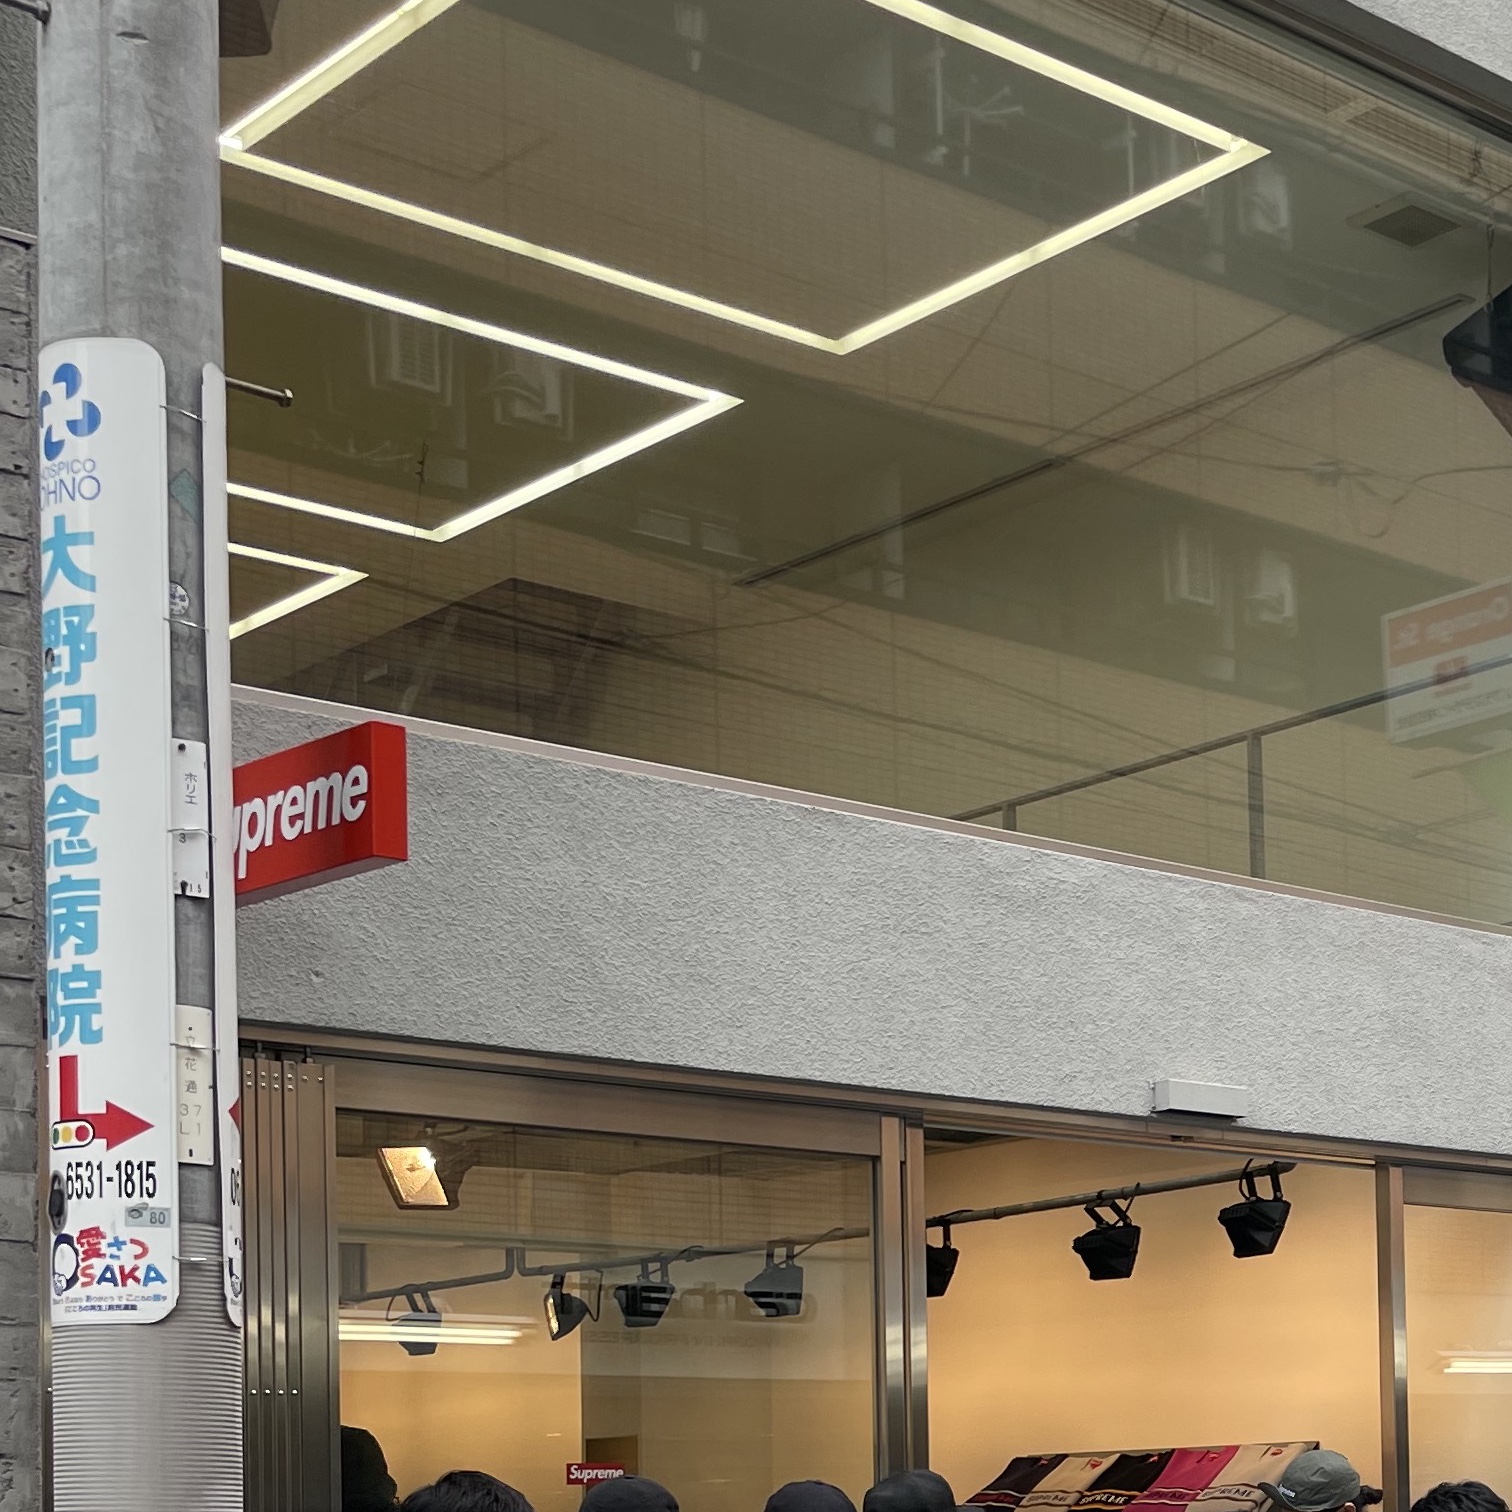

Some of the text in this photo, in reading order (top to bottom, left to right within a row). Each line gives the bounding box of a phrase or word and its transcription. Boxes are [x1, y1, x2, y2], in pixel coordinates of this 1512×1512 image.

[41, 458, 97, 480] OSPICO
[41, 514, 104, 1047] 大野記念病院
[66, 1159, 157, 1200] 6531-1815
[569, 1464, 624, 1484] Supreme
